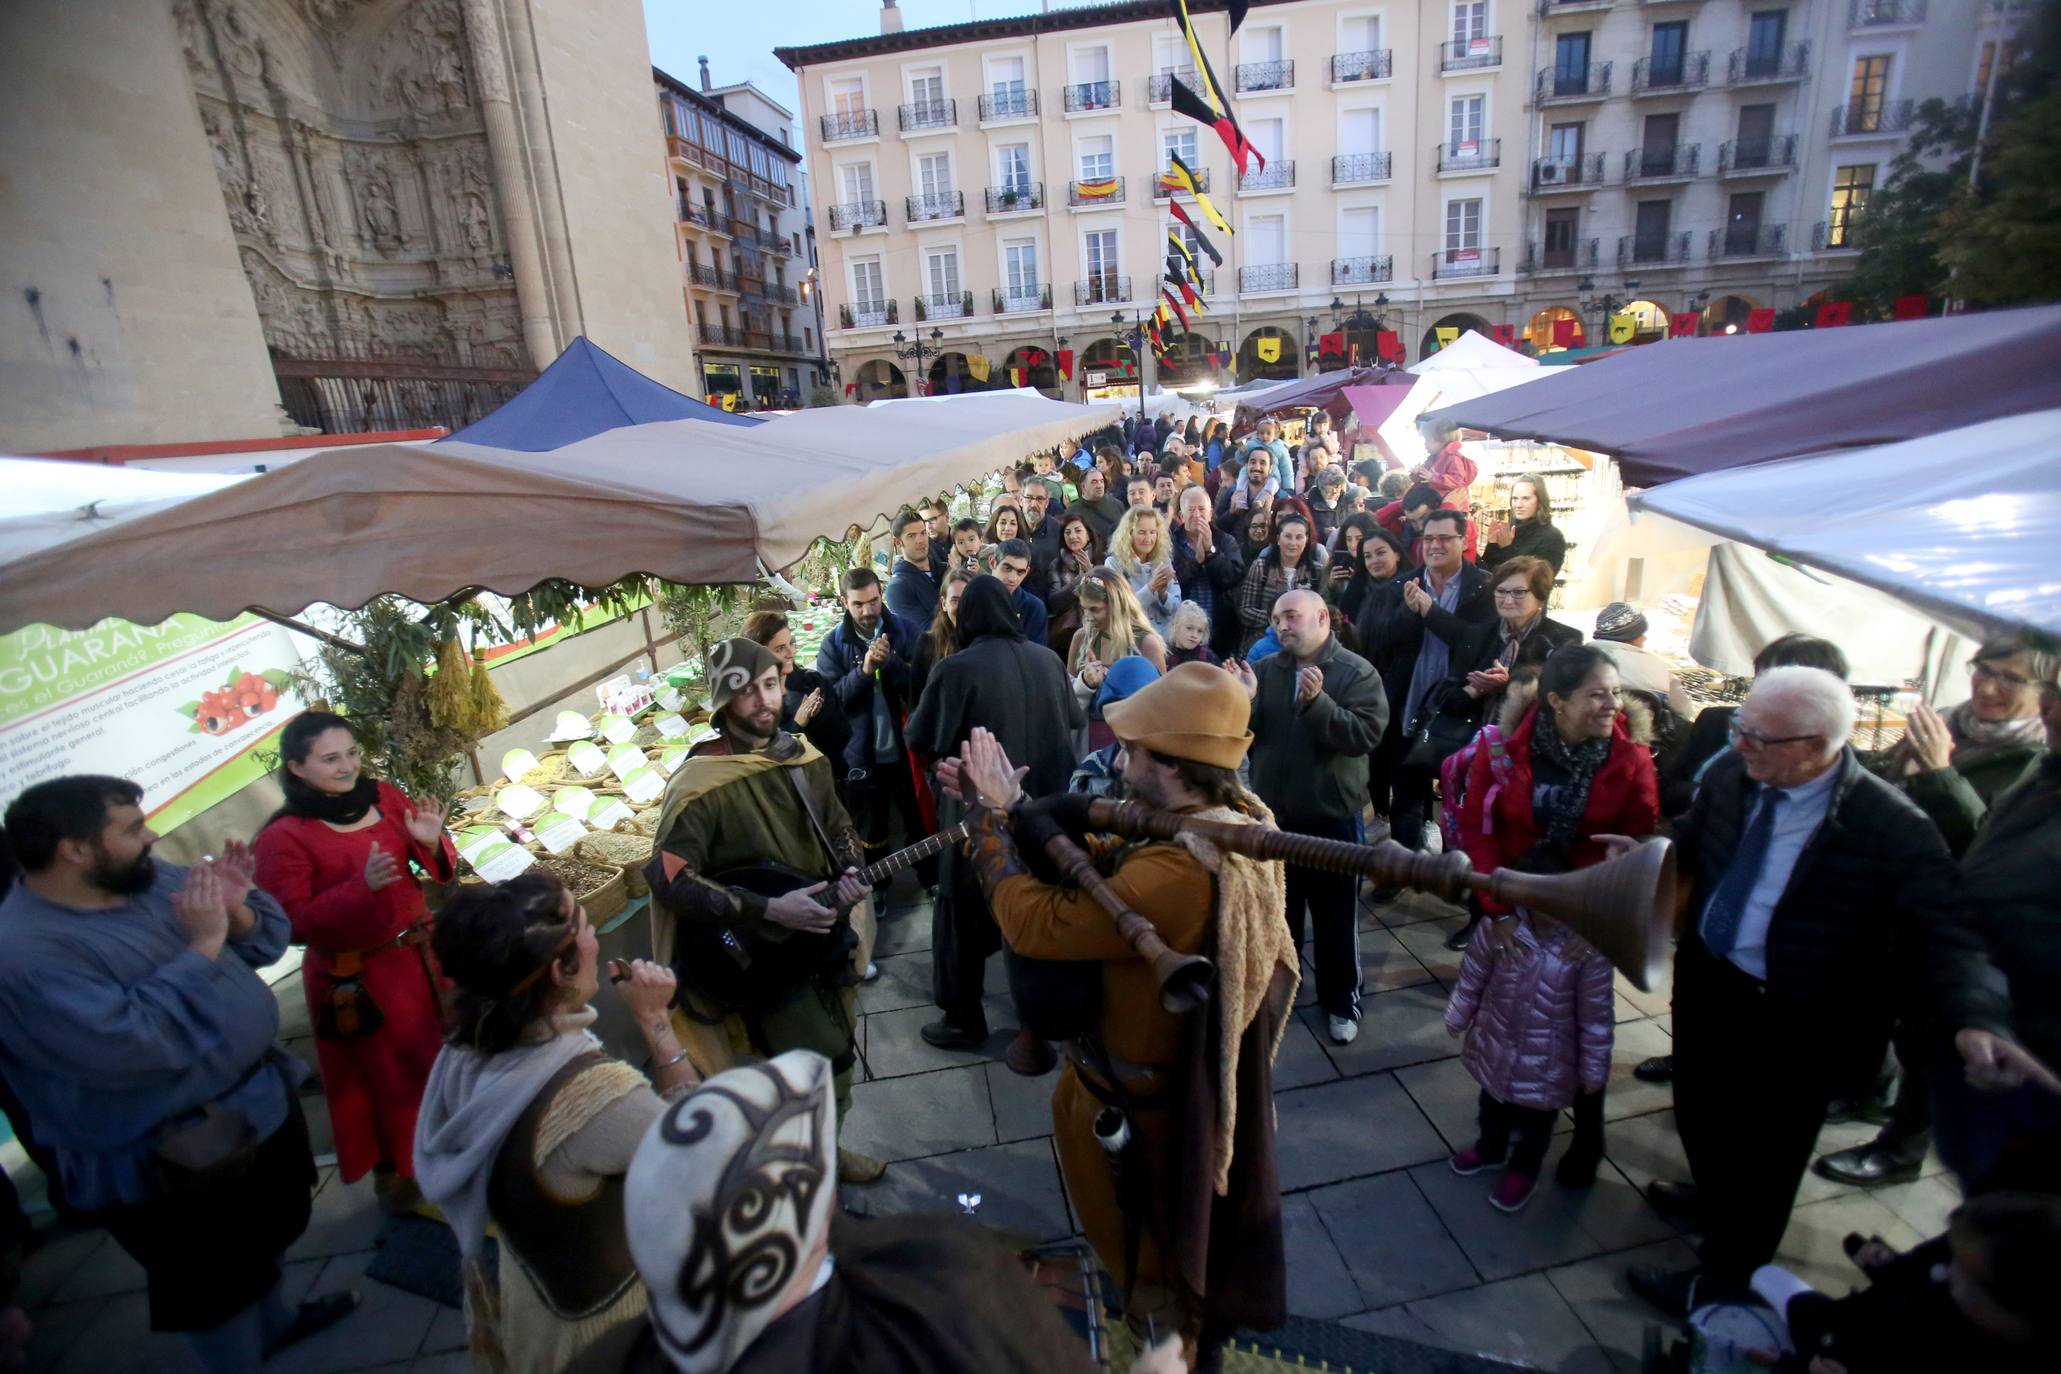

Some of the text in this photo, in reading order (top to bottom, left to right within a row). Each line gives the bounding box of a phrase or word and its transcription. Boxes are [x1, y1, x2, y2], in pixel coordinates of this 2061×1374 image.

[9, 728, 38, 747] sobre
[41, 722, 51, 734] el
[51, 711, 79, 728] tejido
[81, 693, 120, 716] muscular
[121, 677, 163, 698] haciendo
[164, 666, 187, 682] cesar
[197, 652, 219, 667] fatiga
[10, 736, 49, 759] sistema
[51, 718, 90, 741] nervioso
[93, 703, 124, 722] central
[124, 686, 169, 710] facilitando
[180, 664, 216, 686] actividad
[34, 687, 53, 704] el
[9, 744, 65, 775] estimulante
[160, 775, 170, 785] en
[170, 768, 183, 780] las
[183, 753, 212, 773] estados
[213, 747, 223, 757] de
